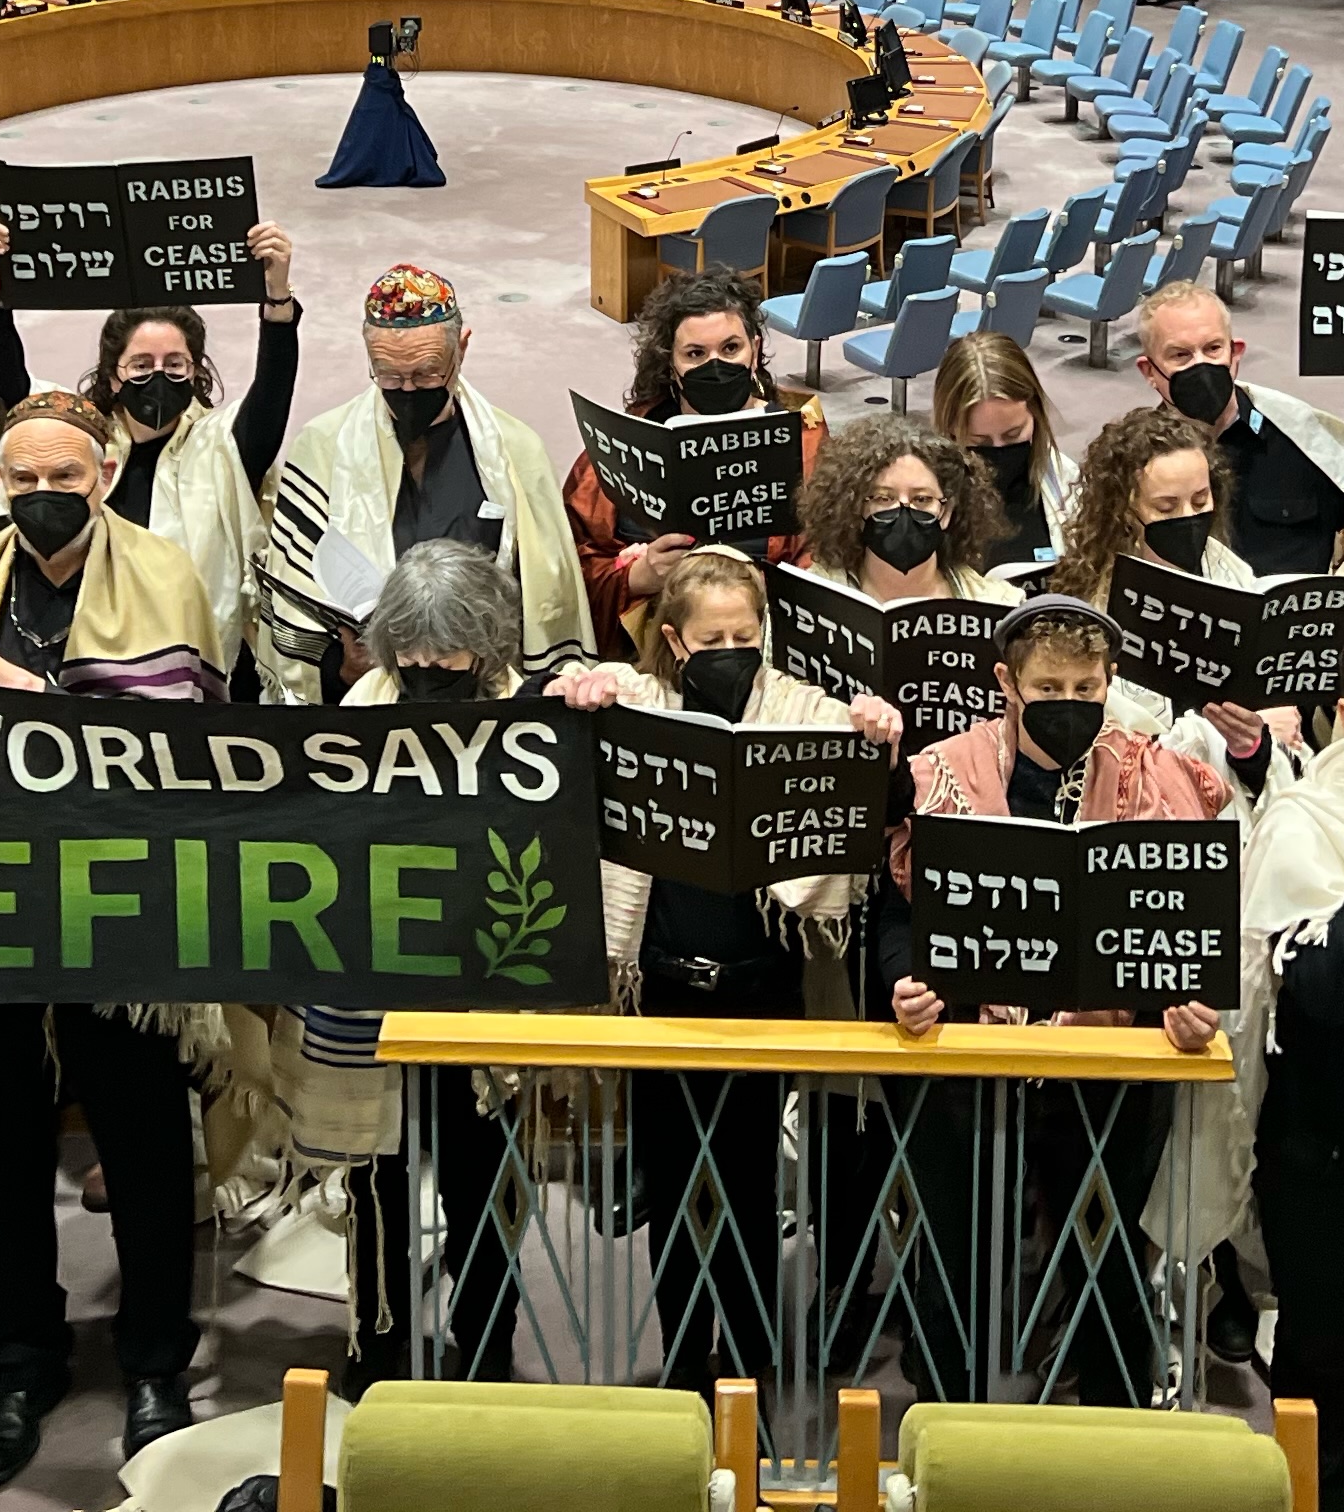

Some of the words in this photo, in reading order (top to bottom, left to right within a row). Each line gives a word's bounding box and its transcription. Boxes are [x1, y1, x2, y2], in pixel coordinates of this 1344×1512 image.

[127, 175, 245, 202] RABBIS
[0, 202, 111, 230] רודפי
[168, 214, 214, 231] FOR
[11, 242, 115, 279] שלום
[143, 242, 248, 267] CEASE
[164, 268, 235, 291] FIRE
[582, 420, 665, 479] רודפי
[679, 427, 791, 460] RABBIS
[716, 460, 758, 481] FOR
[596, 460, 667, 521] שלום
[690, 481, 788, 517] CEASE
[708, 505, 773, 536] FIRE
[778, 598, 875, 669] רודפי
[892, 613, 1004, 642] RABBI
[1123, 588, 1241, 649] רודפי
[1287, 622, 1335, 639] FOR
[927, 650, 976, 670] FOR
[1122, 629, 1232, 687] שלום
[1255, 648, 1339, 676] CEAS
[898, 681, 1006, 714] CEASE
[1265, 671, 1339, 695] FIRE
[915, 706, 987, 734] FIR
[303, 719, 560, 802] SAYS
[599, 740, 717, 795] רודפי
[745, 738, 880, 768] RABBIS
[784, 776, 836, 795] FOR
[603, 798, 716, 851] שלום
[750, 806, 868, 838] CEASE
[768, 833, 848, 864] FIRE
[1087, 842, 1229, 874] RABBIS
[924, 868, 1060, 912] רודפי
[1129, 889, 1185, 911] FOR
[929, 925, 1059, 972] שלום
[1095, 928, 1222, 957] CEASE
[1116, 961, 1202, 991] FIRE
